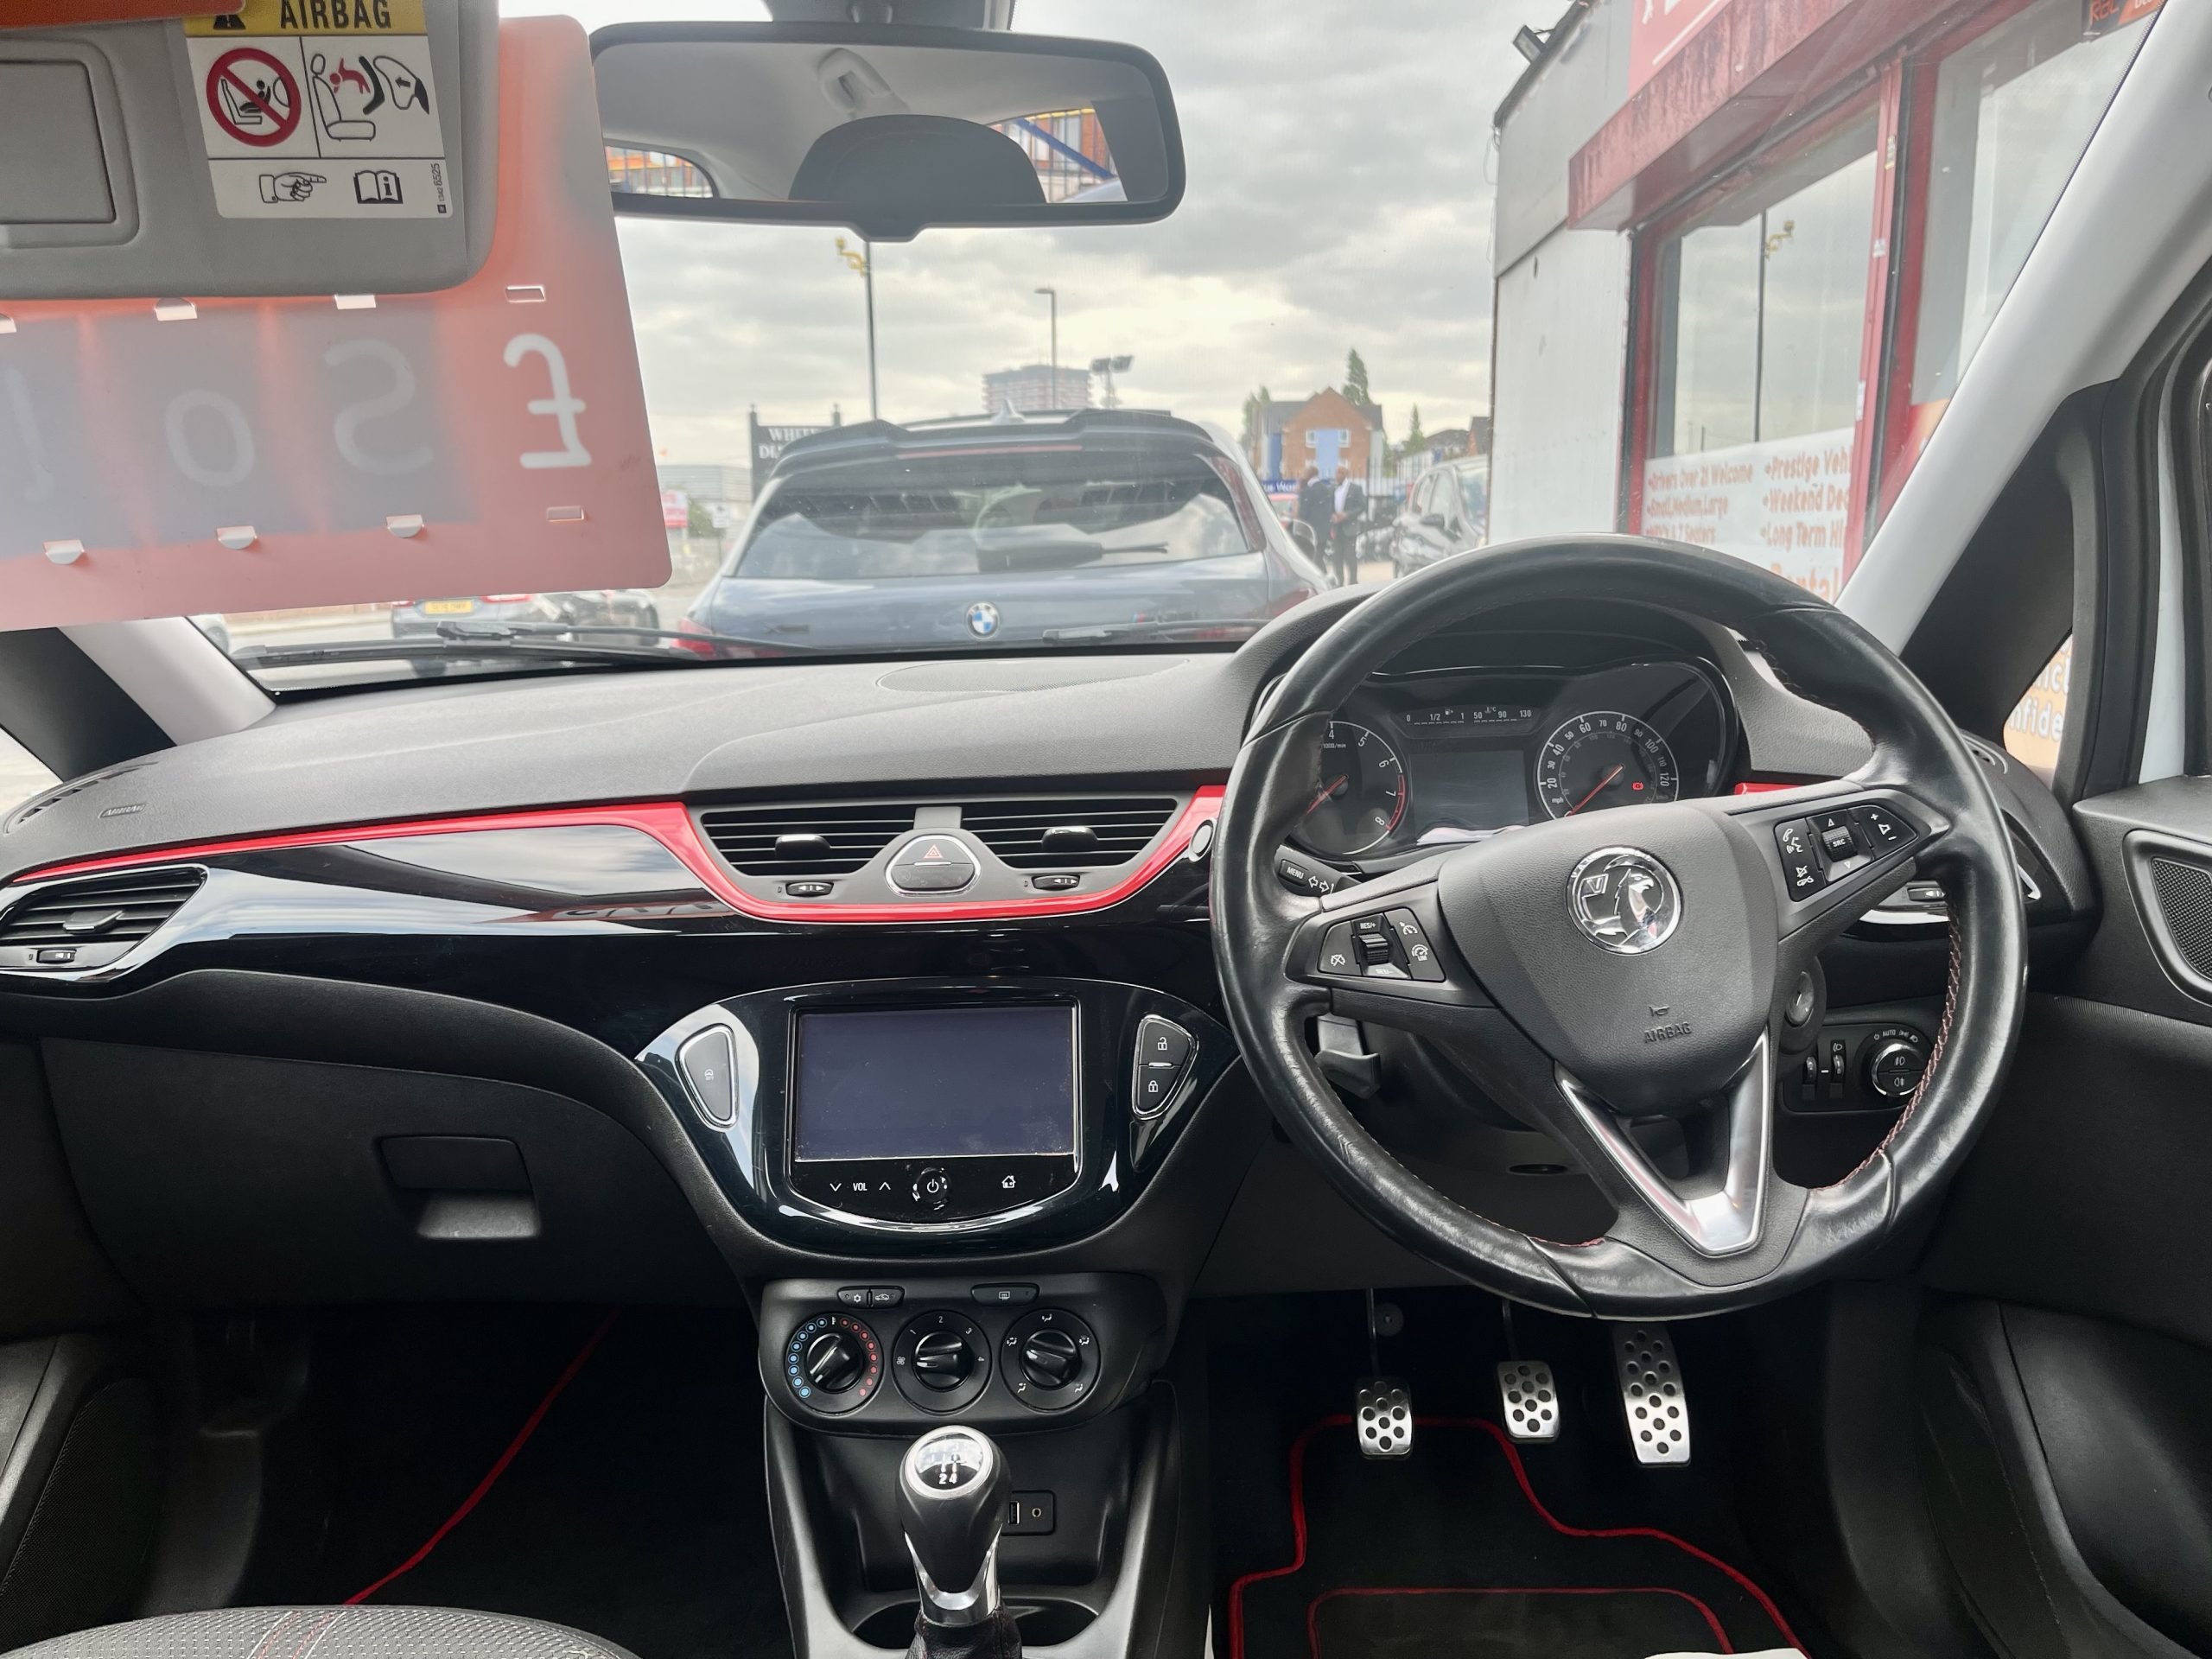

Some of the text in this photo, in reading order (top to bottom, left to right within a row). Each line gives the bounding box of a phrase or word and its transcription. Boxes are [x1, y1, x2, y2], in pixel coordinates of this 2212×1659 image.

[280, 0, 391, 29] AIRBAG
[1771, 453, 1819, 480] Prestige
[1712, 463, 1753, 484] Welcome
[1770, 486, 1824, 512] Weekend
[1767, 523, 1793, 551] Long
[1796, 520, 1827, 549] Term
[1406, 714, 1411, 722] 0
[1429, 713, 1440, 721] 1/2
[1497, 710, 1507, 719] 90
[1519, 709, 1532, 718] 130
[1579, 721, 1592, 734] 60
[1615, 721, 1627, 732] 80
[1328, 729, 1335, 740] 4
[1564, 731, 1574, 741] 50
[1634, 728, 1643, 738] 90
[1357, 736, 1367, 747] 5
[1644, 738, 1659, 753] 100
[1552, 744, 1565, 756] 40
[1378, 760, 1389, 768] 6
[1547, 760, 1556, 770] 30
[1658, 756, 1668, 767] 110
[1547, 778, 1558, 789] 20
[1660, 772, 1670, 787] 120
[1551, 796, 1564, 804] mph
[1375, 816, 1385, 826] 8
[1833, 838, 1846, 848] SRC
[1287, 866, 1305, 880] MENU
[1644, 1021, 1692, 1044] AIRBAG
[1882, 1029, 1896, 1038] AUTO
[853, 1182, 868, 1192] VOL
[938, 1315, 944, 1324] 2
[938, 1472, 958, 1485] 2 4
